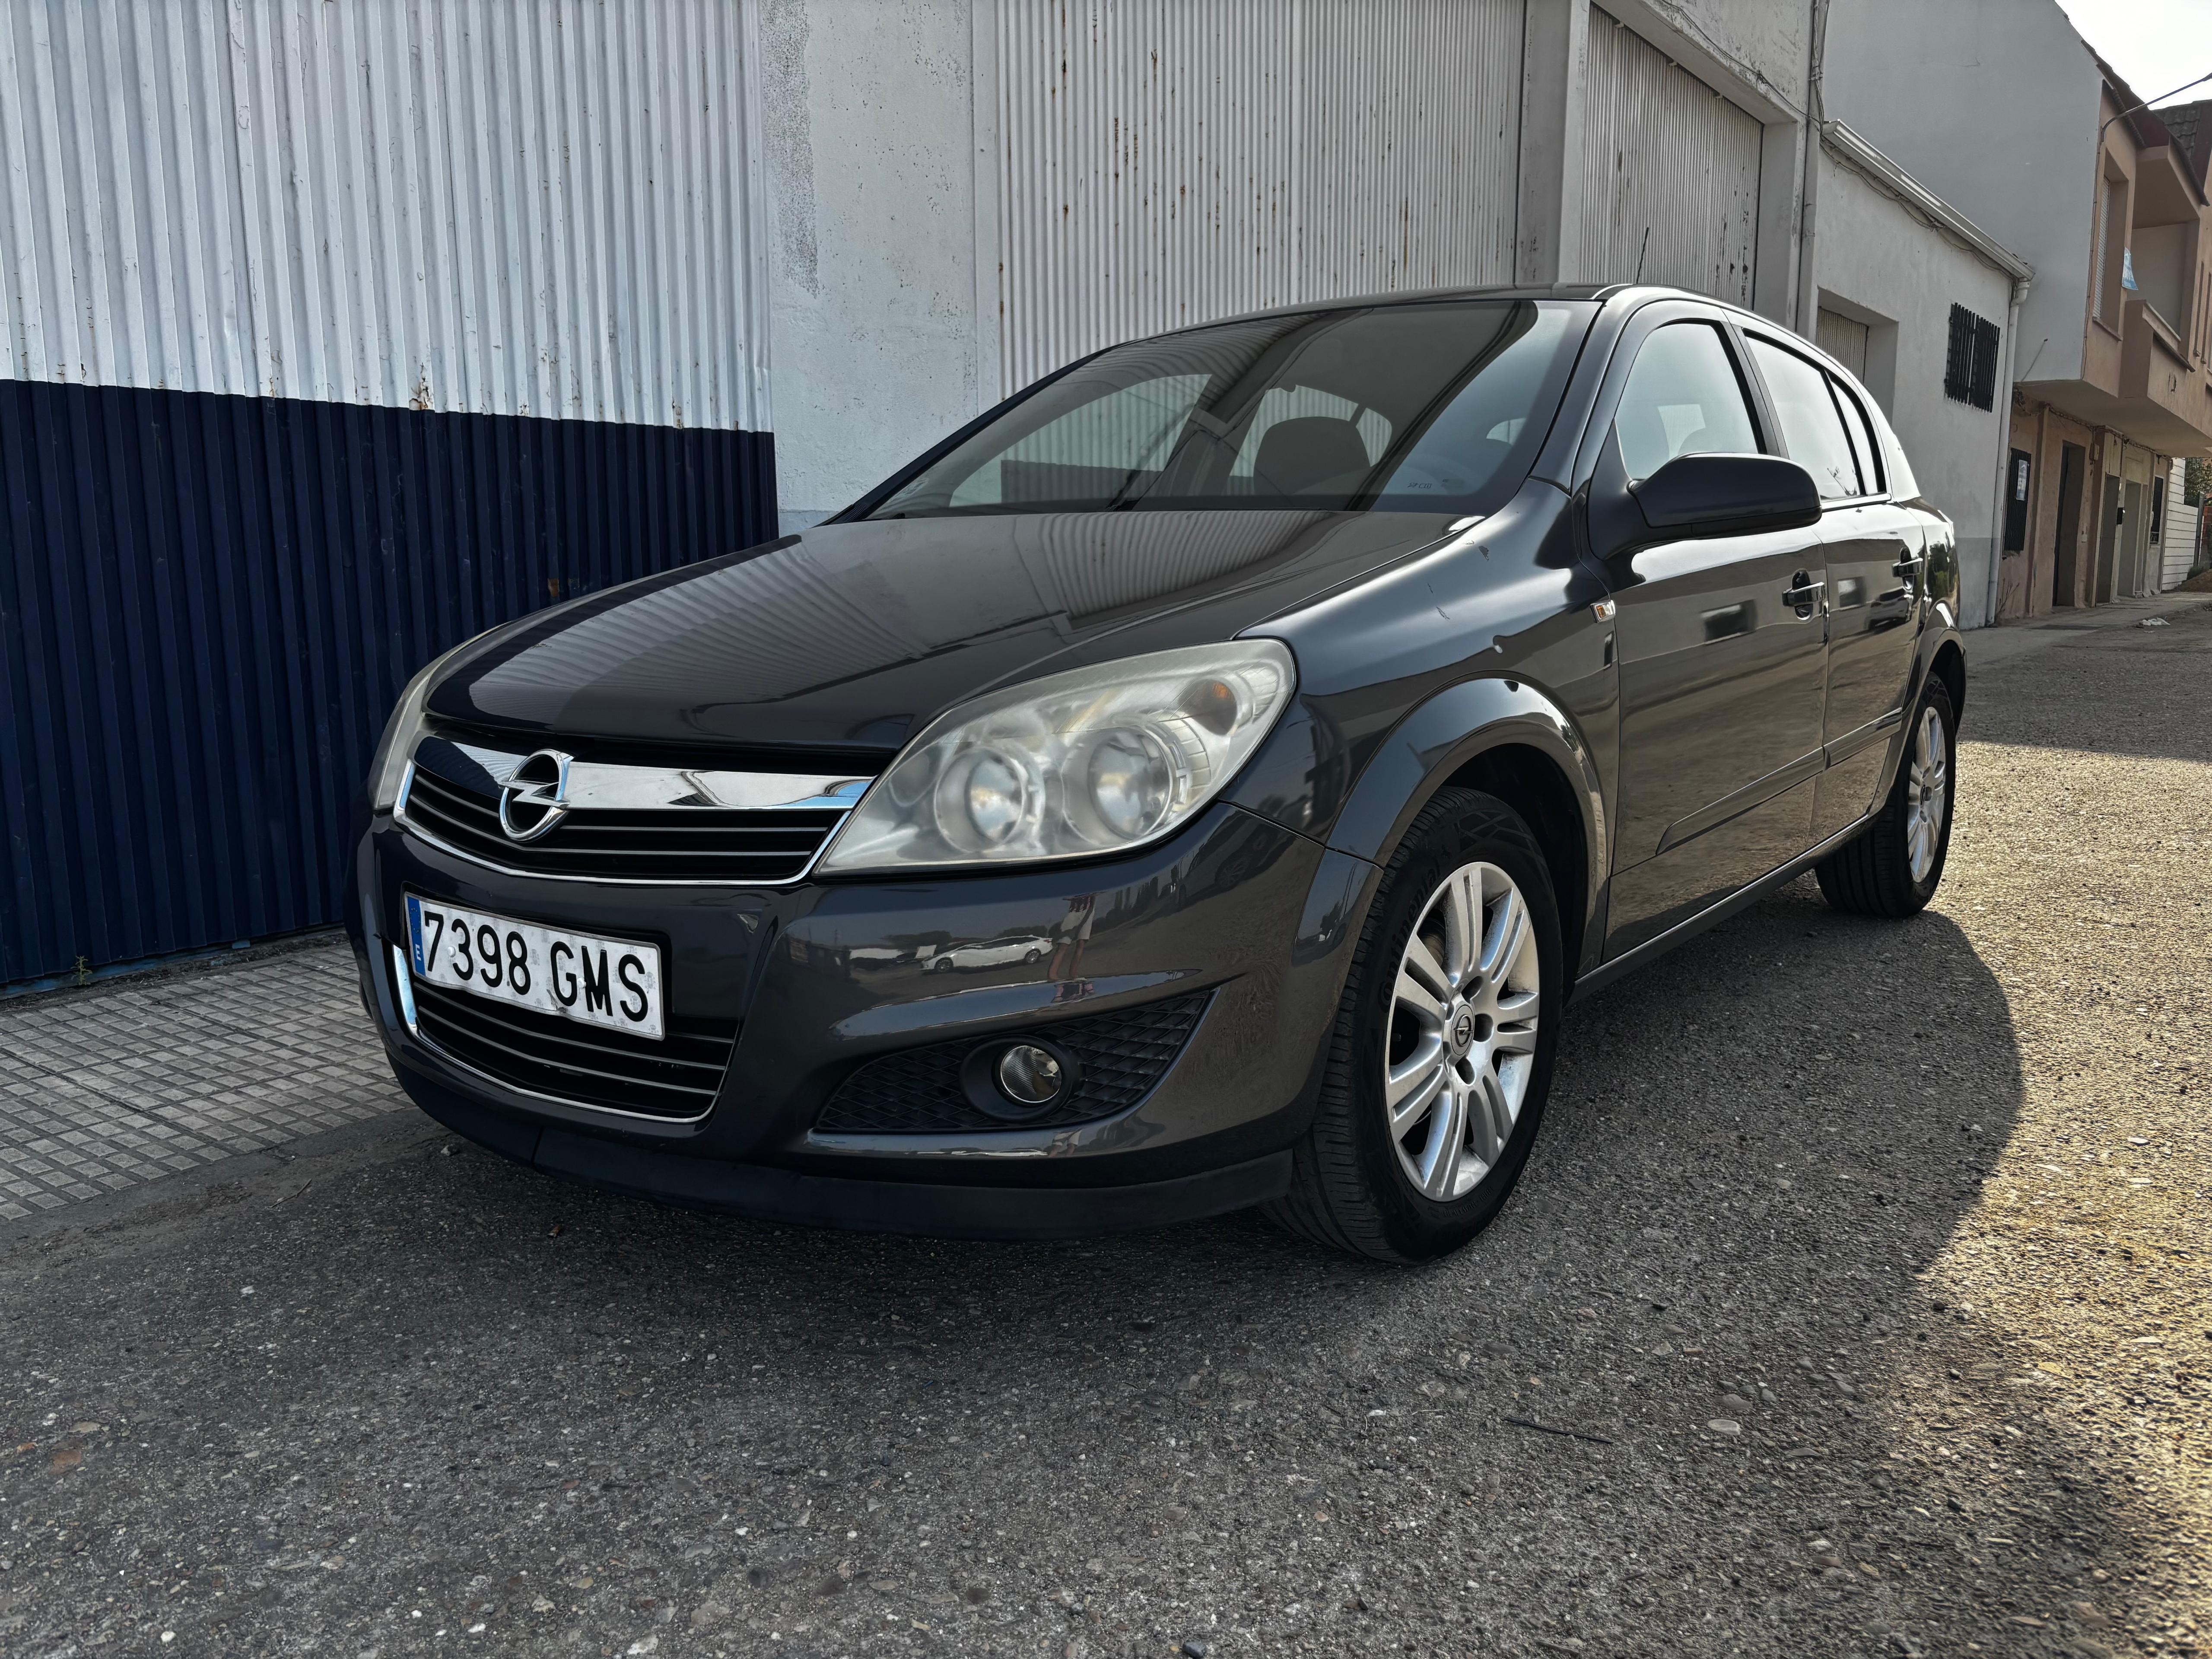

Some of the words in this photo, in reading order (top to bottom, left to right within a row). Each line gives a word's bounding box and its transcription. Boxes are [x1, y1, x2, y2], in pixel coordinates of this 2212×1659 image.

[415, 944, 421, 961] E
[424, 910, 531, 995] 7398
[550, 941, 648, 1022] GMS
